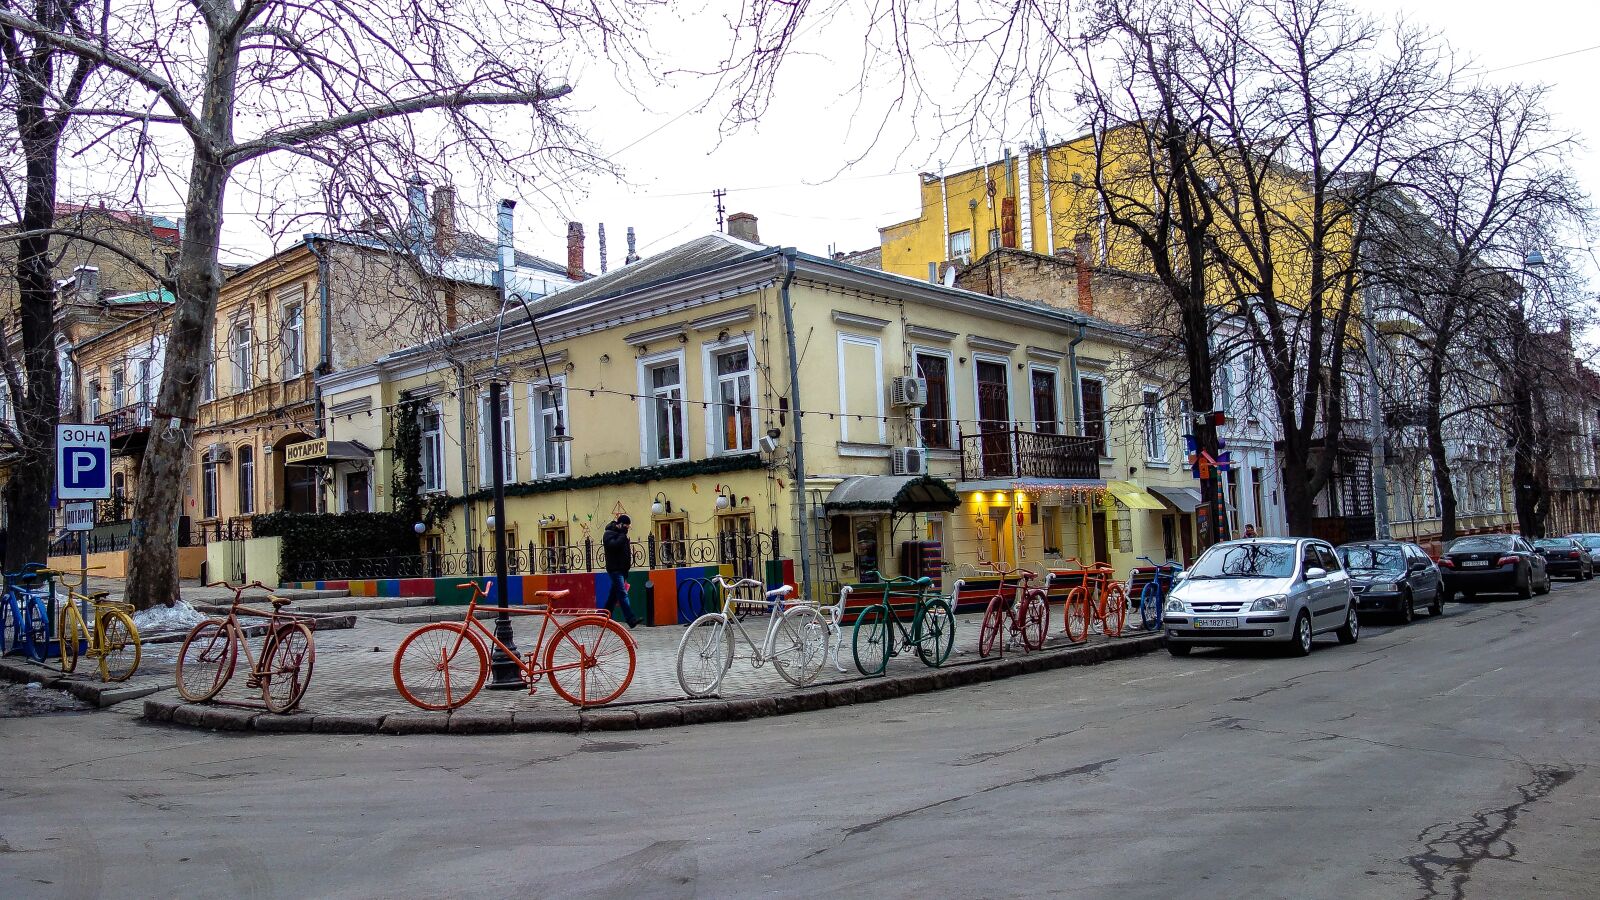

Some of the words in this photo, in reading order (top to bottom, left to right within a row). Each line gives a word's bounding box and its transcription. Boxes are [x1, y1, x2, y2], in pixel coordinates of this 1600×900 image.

[63, 429, 106, 442] ЗОНА
[287, 441, 325, 460] НОТАРІУС
[72, 451, 97, 484] P
[66, 509, 93, 524] НОТАРІУС
